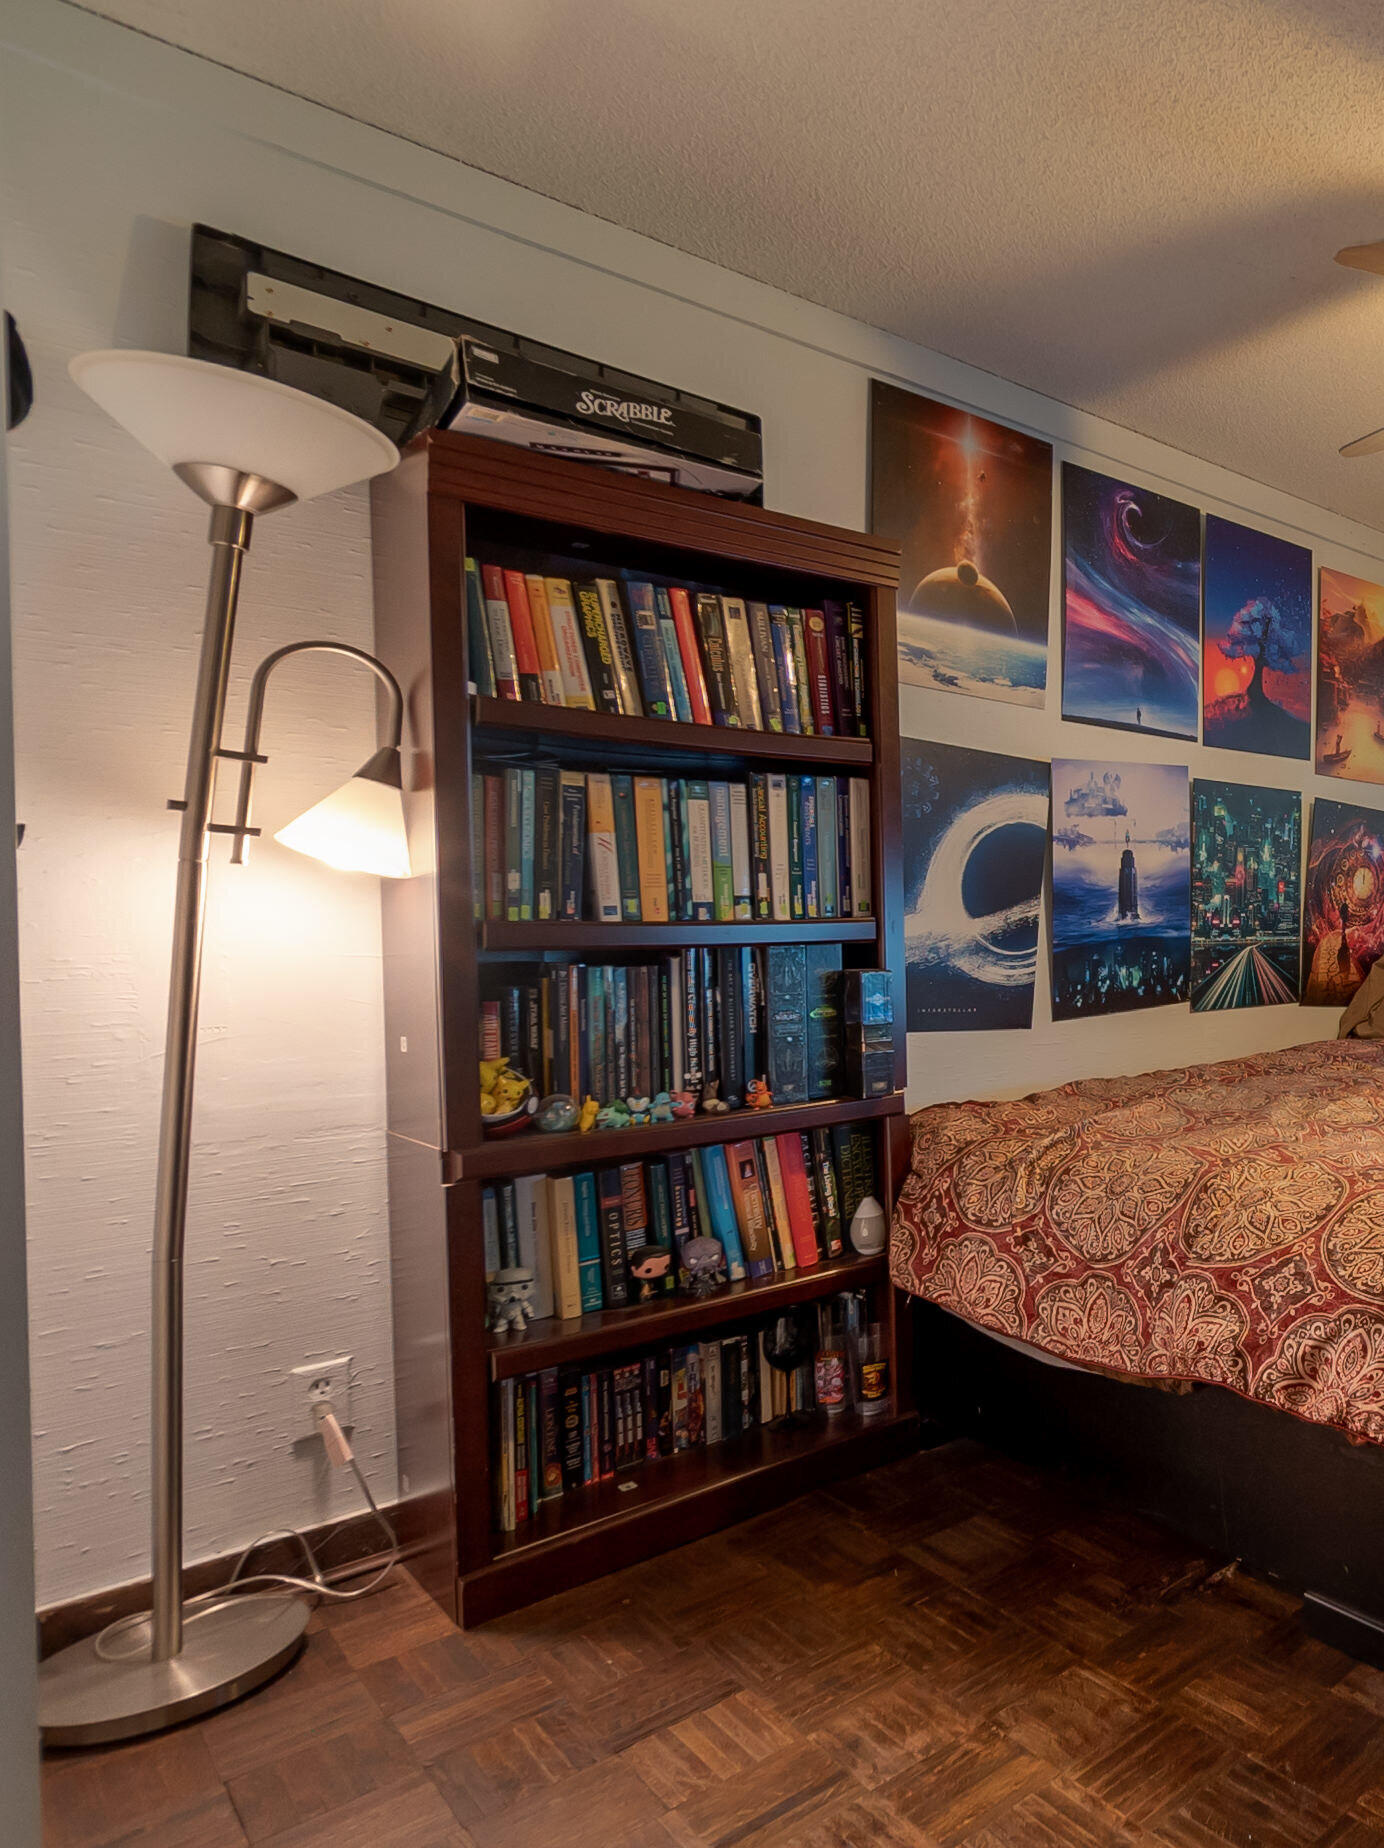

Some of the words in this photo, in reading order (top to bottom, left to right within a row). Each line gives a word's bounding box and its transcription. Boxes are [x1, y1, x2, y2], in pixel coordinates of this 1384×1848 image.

[575, 391, 677, 427] SCRABBLE
[579, 592, 597, 638] GRAPHICS
[588, 592, 612, 665] SUPERCHARGED
[756, 611, 769, 653] SULLIVAN
[708, 637, 726, 672] Calculus
[817, 674, 830, 715] STATISTICS
[715, 786, 728, 857] management
[758, 813, 768, 860] Accounting
[528, 1001, 538, 1024] STAR
[748, 962, 757, 1033] OVERWATCH
[916, 1006, 977, 1014] INTERSTELLAR
[528, 1025, 538, 1049] WARS
[728, 1031, 736, 1081] ENTERTAINMENT
[822, 1161, 831, 1175] The
[823, 1174, 833, 1197] Living
[840, 1144, 853, 1221] DICTIONARY
[861, 1135, 873, 1197] ILLUSTRA
[746, 1184, 763, 1229] Chemistry
[826, 1196, 837, 1217] World
[608, 1212, 623, 1266] OPTICS
